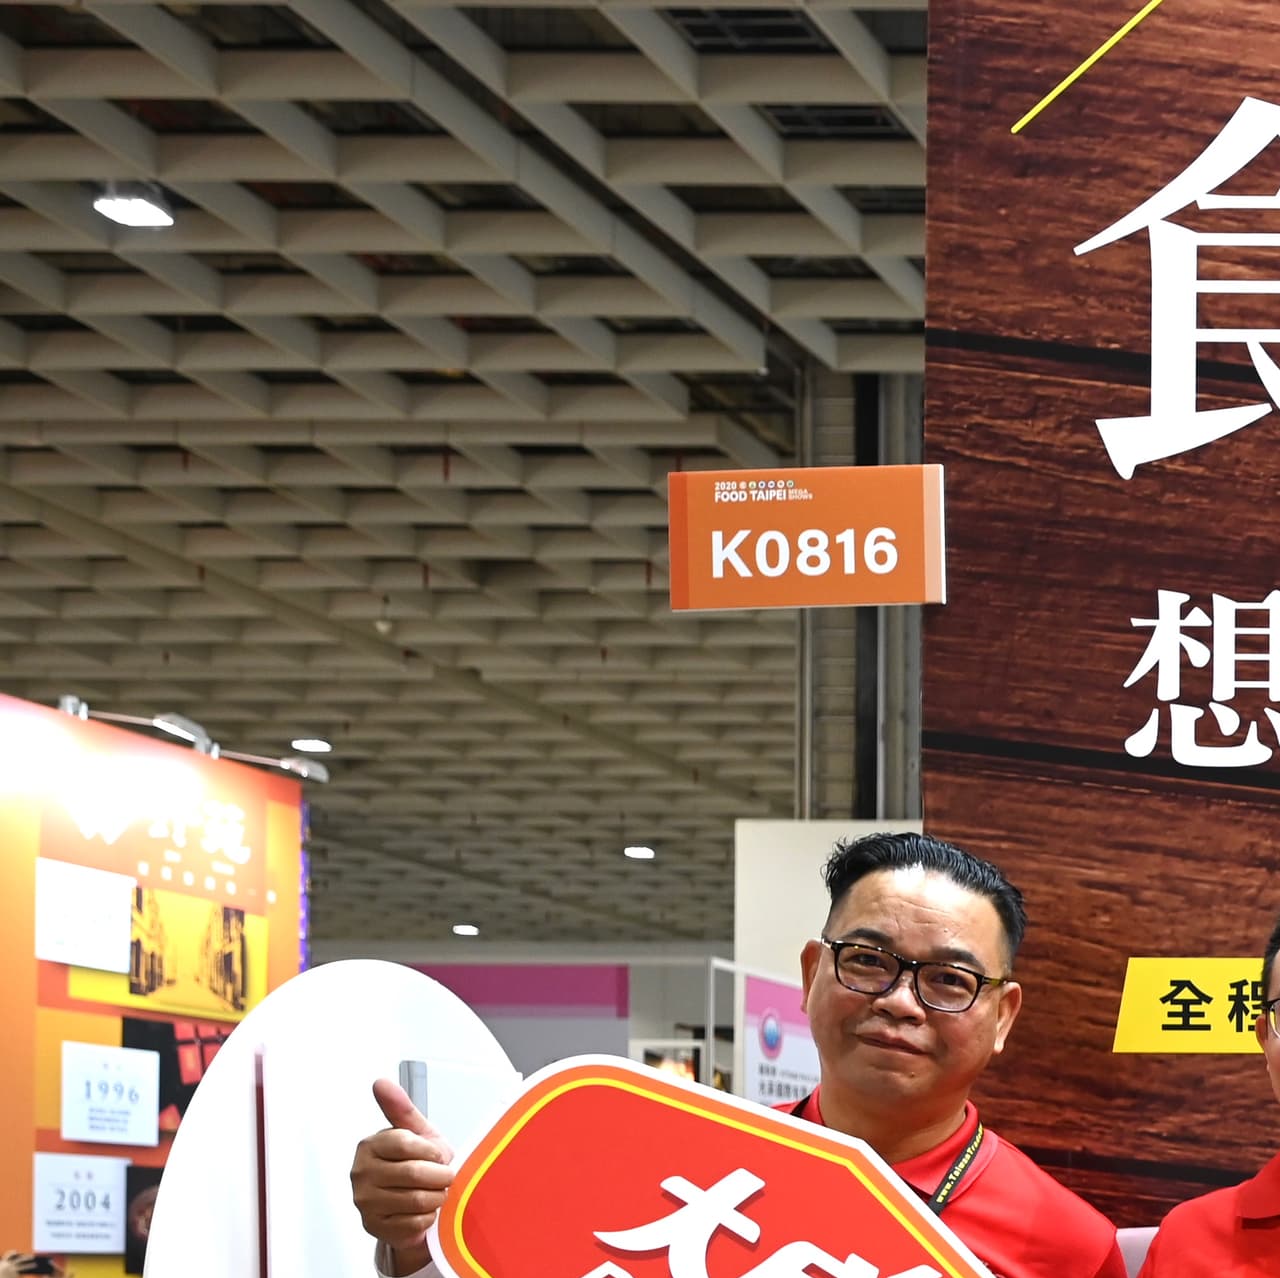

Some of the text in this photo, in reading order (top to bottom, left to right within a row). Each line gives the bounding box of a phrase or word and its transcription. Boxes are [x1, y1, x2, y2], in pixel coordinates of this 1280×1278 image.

[714, 481, 737, 491] 2020
[714, 489, 787, 503] FOOD TAIPEI
[711, 526, 898, 579] K0816
[84, 1079, 140, 1104] 1996
[55, 1189, 112, 1212] 2004
